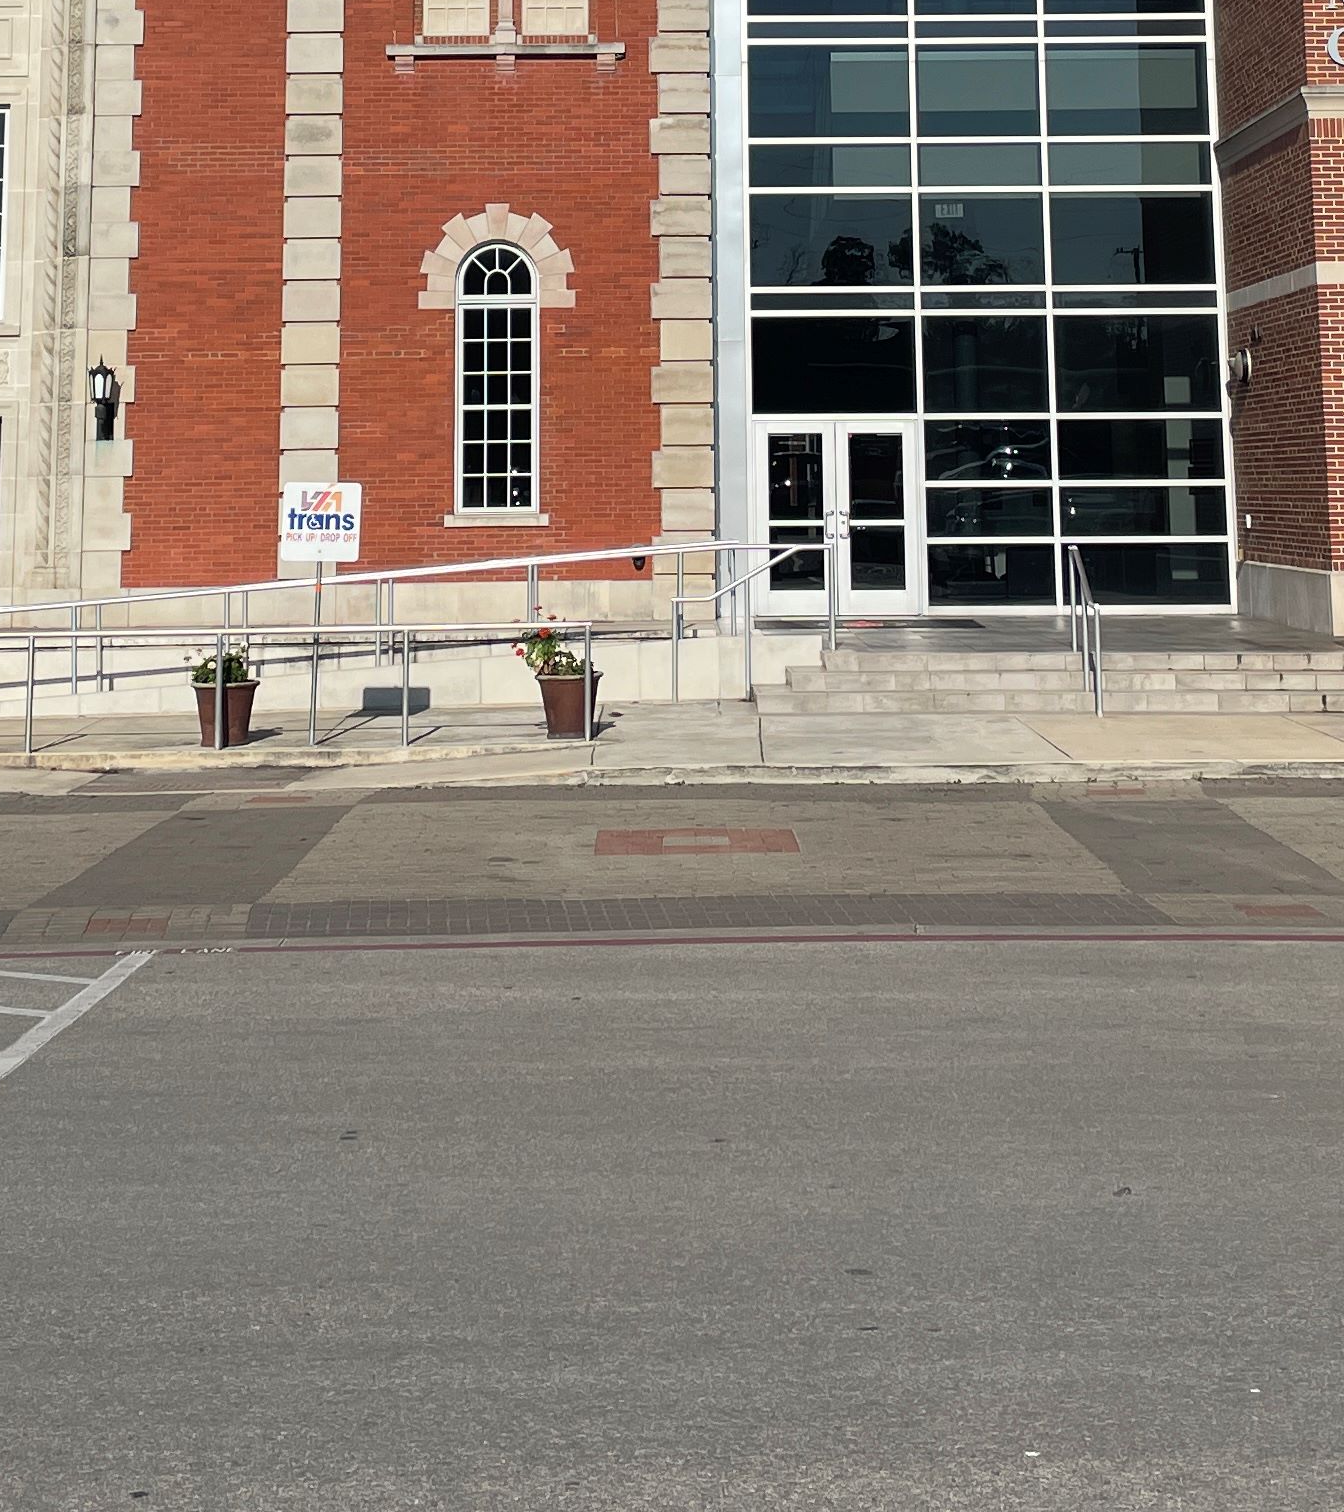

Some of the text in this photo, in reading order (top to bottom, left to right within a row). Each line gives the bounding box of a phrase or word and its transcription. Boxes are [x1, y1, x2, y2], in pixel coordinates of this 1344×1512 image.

[287, 507, 355, 531] trans
[286, 532, 302, 543] PICK
[320, 532, 341, 543] DROP
[343, 532, 358, 543] OFF
